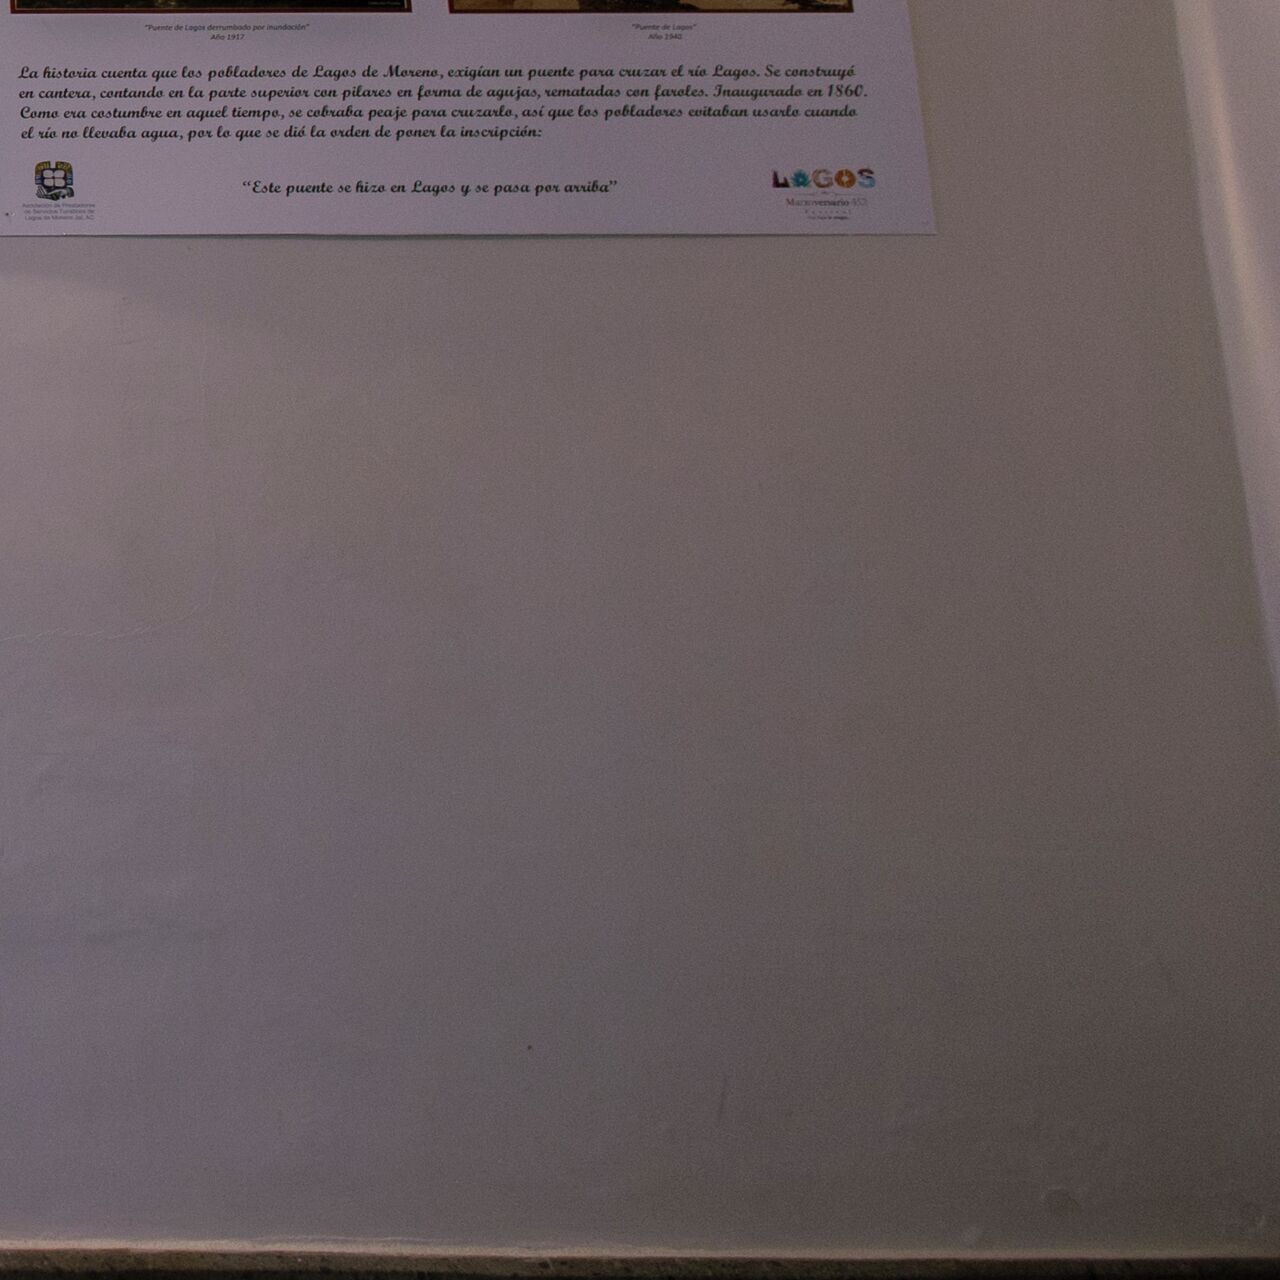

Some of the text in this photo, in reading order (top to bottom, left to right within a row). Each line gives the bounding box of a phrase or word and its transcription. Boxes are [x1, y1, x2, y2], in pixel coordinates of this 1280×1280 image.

[242, 180, 617, 197] “Este puente se hizo en Lagos y se pasa por arriba”
